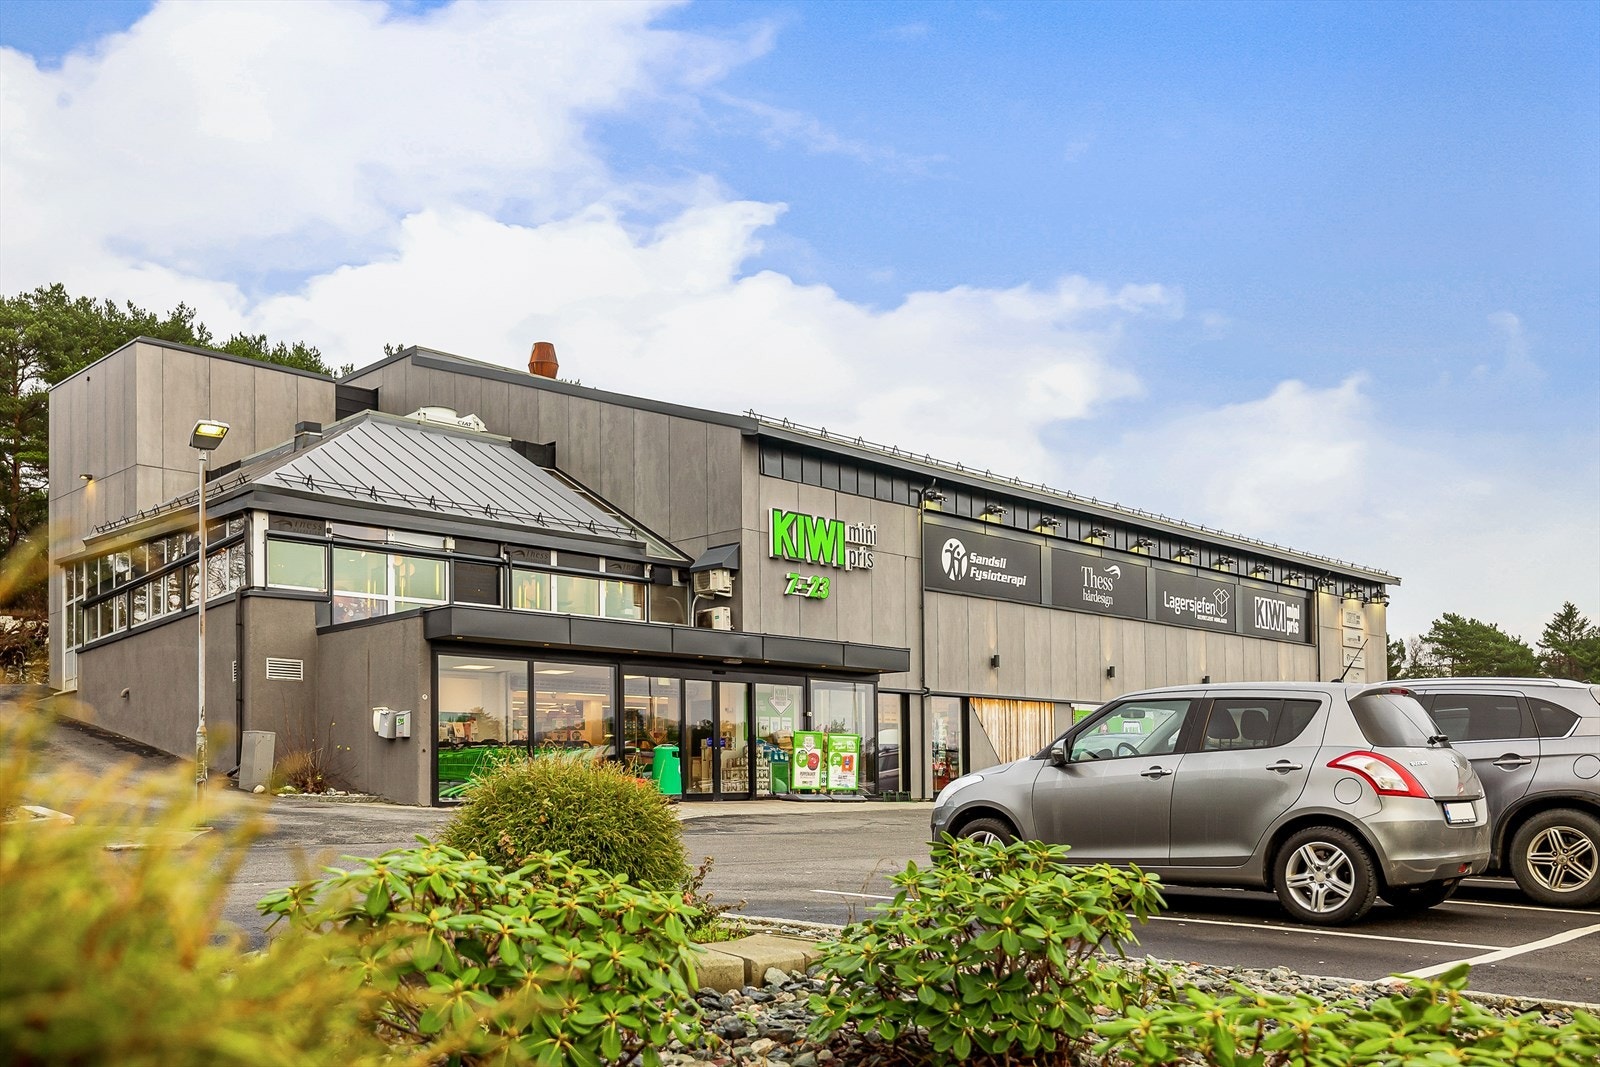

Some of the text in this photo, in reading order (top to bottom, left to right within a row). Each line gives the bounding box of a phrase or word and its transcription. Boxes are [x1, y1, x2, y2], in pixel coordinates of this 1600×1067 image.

[769, 508, 846, 567] KIWI
[848, 522, 877, 546] mini
[848, 547, 874, 571] pris
[969, 552, 1007, 569] Sandsli
[969, 566, 1027, 587] Fysioterapi
[1081, 566, 1113, 591] Thess
[1082, 588, 1114, 608] hårdesign
[1163, 590, 1216, 618] Lagersjefen
[1254, 596, 1287, 632] KIWI
[1286, 618, 1300, 636] pris
